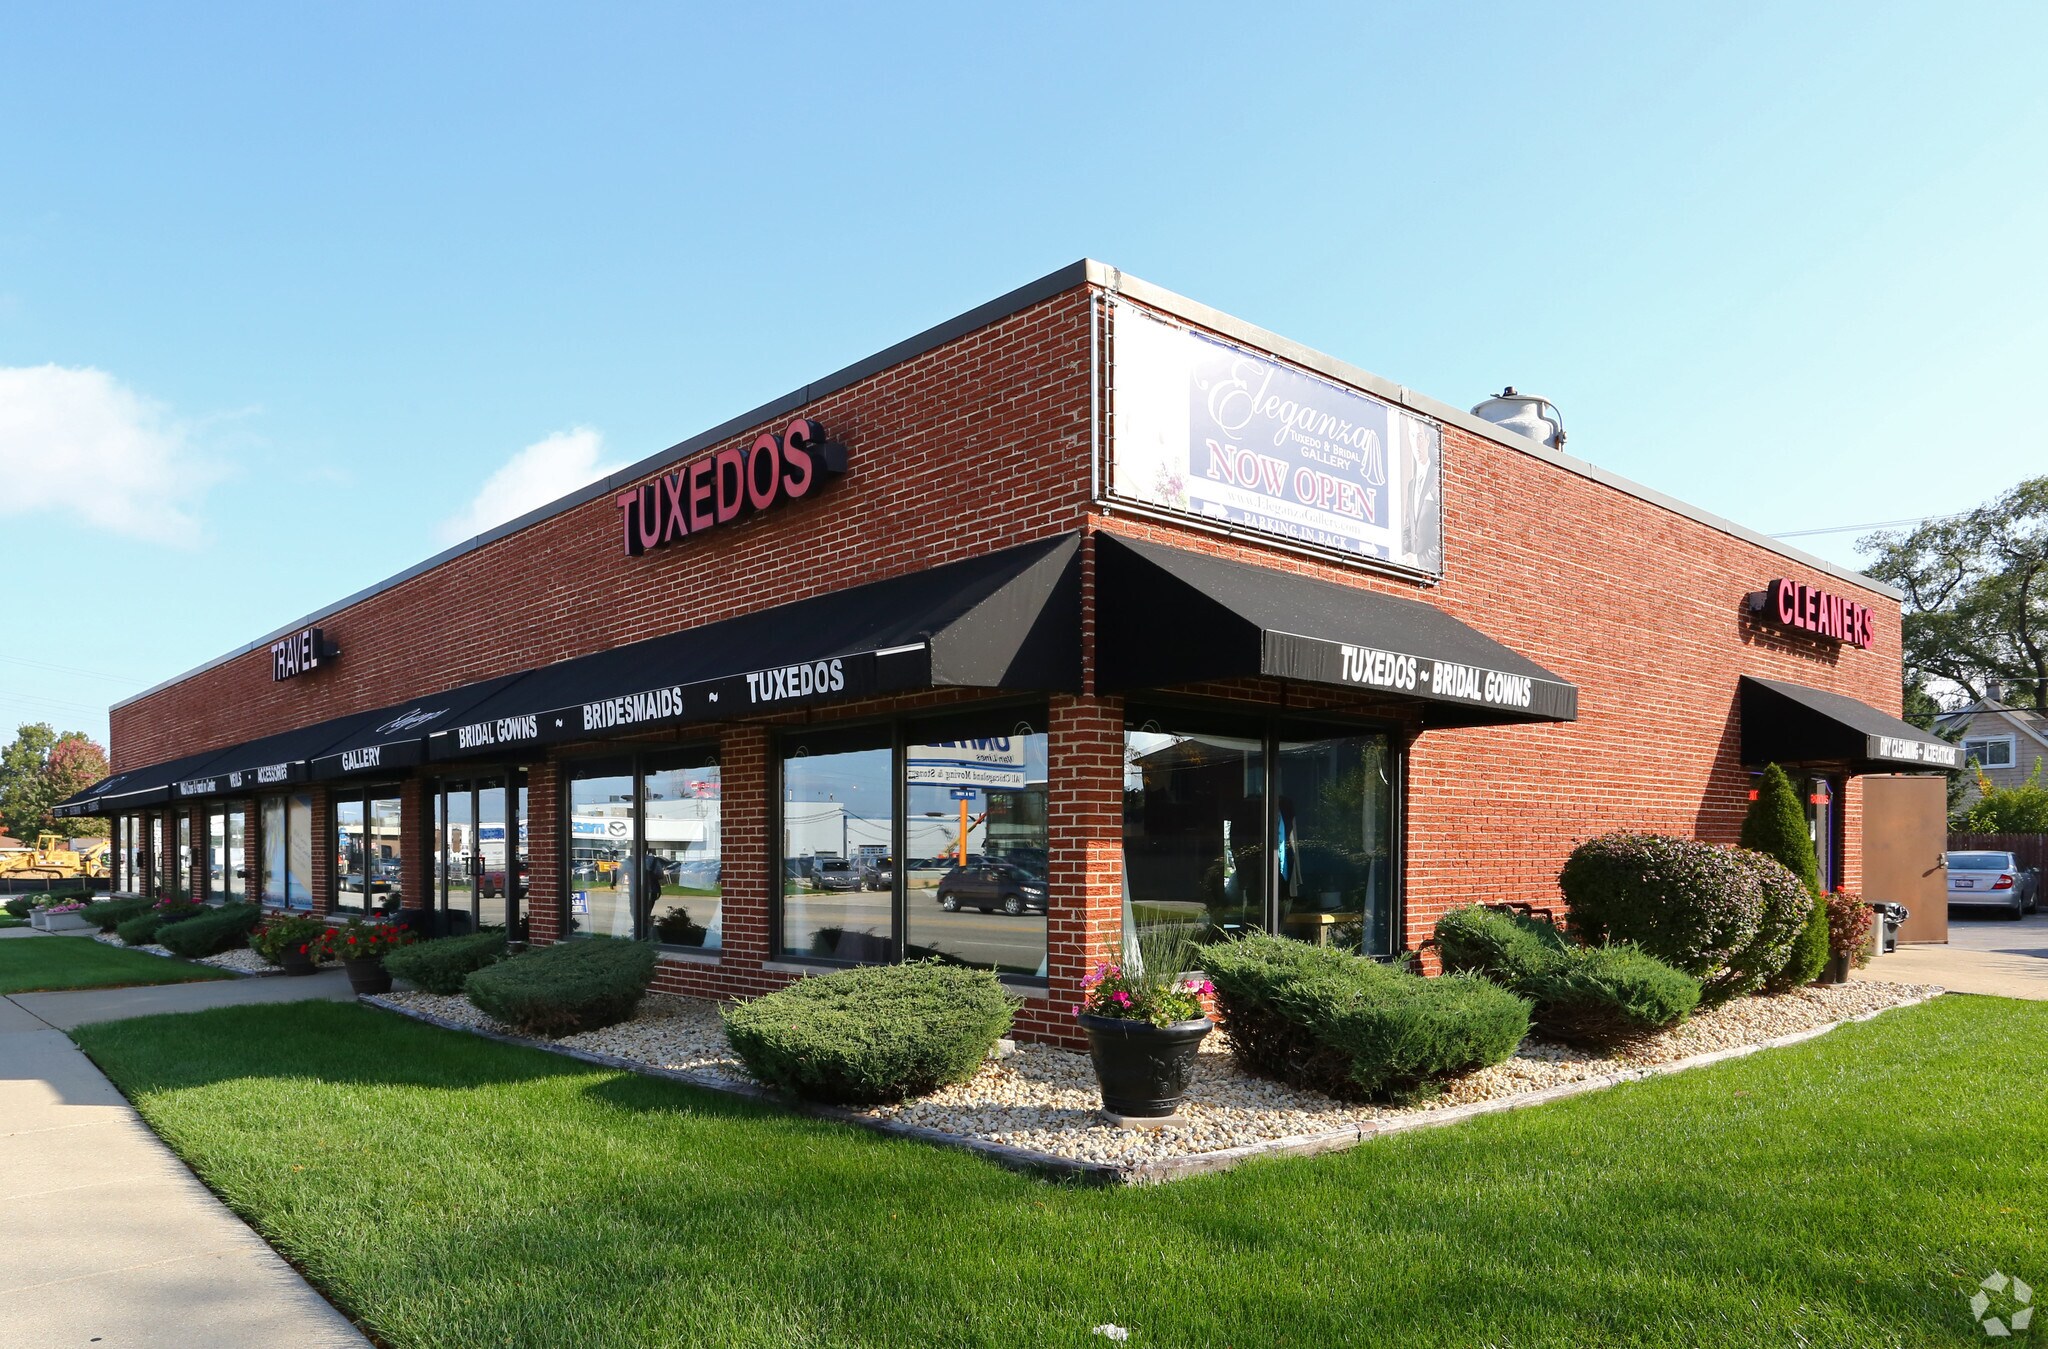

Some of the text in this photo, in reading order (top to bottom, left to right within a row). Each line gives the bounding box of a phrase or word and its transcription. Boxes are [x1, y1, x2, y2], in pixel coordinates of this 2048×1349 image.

[1207, 356, 1374, 447] Eleganza
[1290, 429, 1321, 448] TUXEDO
[1333, 445, 1360, 463] BRIDAL
[1301, 446, 1351, 470] GALLERY
[617, 418, 813, 556] TUXEDOS
[1206, 438, 1376, 523] NOW OPEN
[1244, 512, 1349, 551] PARKING IN BACK
[1778, 577, 1875, 650] CLEANERS
[271, 628, 317, 682] TRAVEL
[1341, 645, 1417, 690] TUXEDOS
[1432, 661, 1481, 701] BRIDAL
[1485, 671, 1532, 708] GOWNS
[459, 723, 495, 749] BRIDAL
[496, 715, 538, 743] GOWNS
[583, 687, 683, 730] BRIDESMAIDS
[746, 659, 844, 703] TUXEDOS
[342, 747, 380, 771] GALLERY
